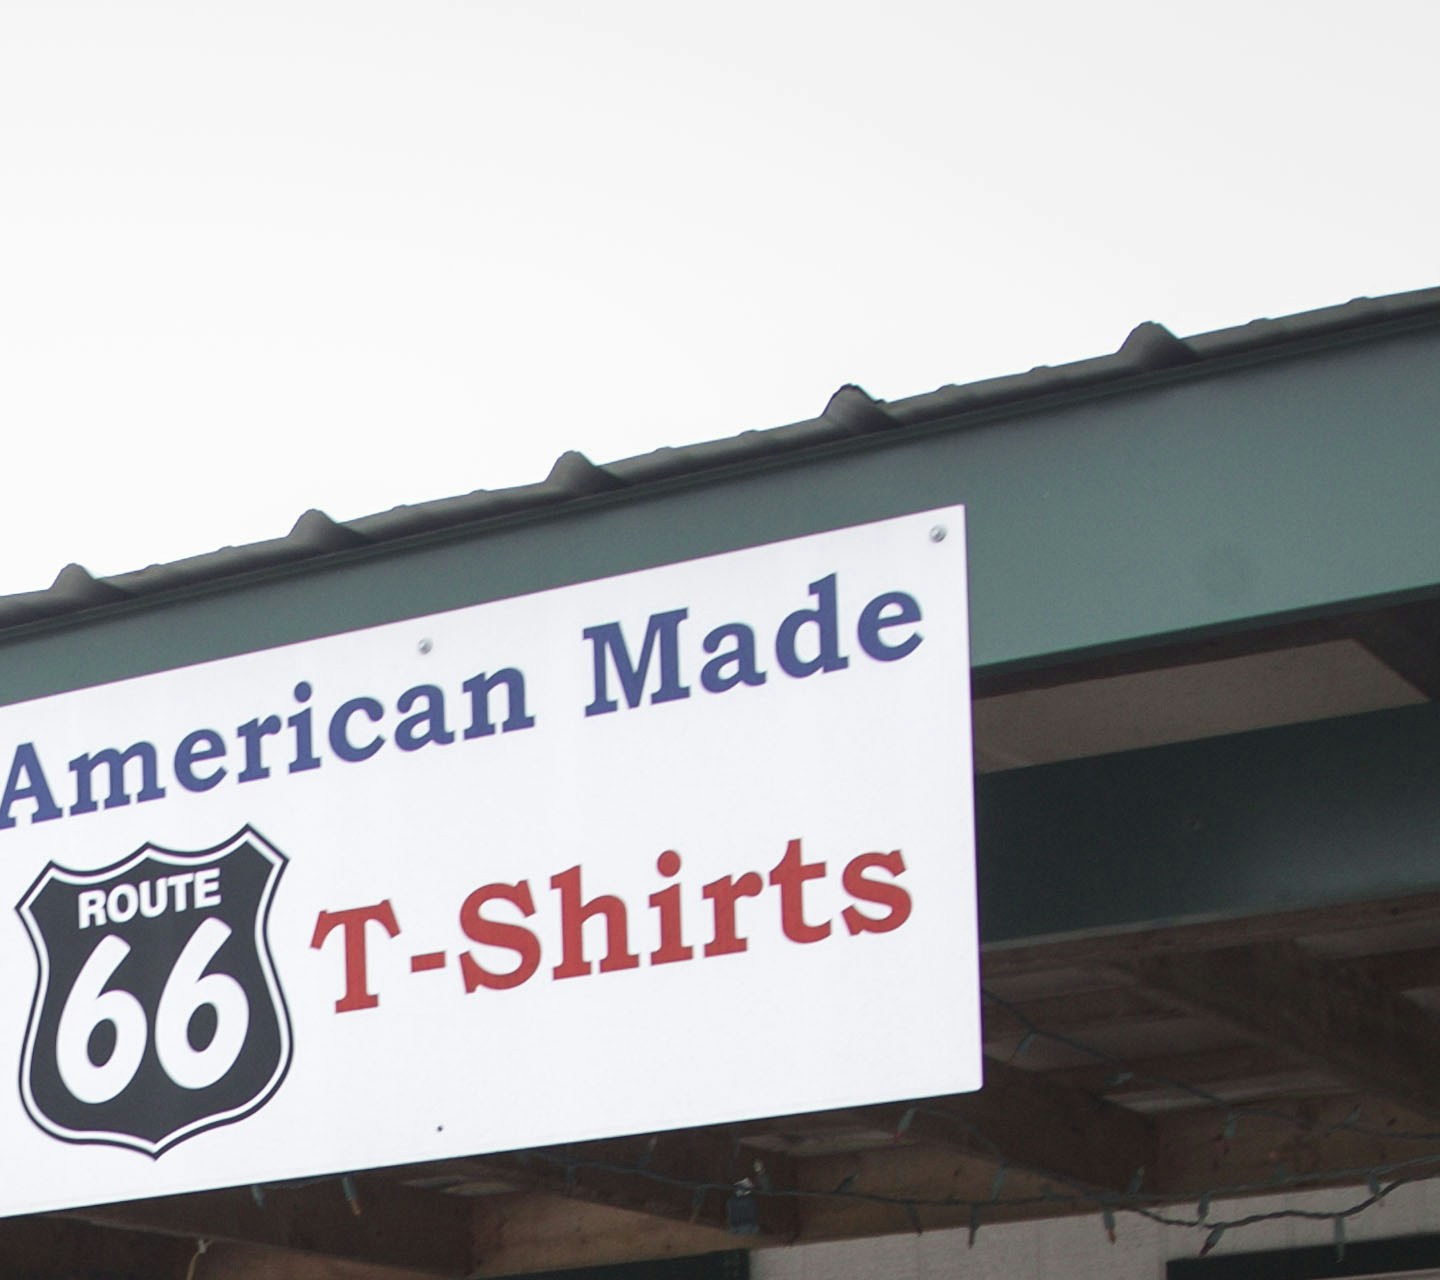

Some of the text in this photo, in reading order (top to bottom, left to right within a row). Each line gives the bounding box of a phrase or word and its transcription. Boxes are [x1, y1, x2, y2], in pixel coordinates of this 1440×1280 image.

[581, 572, 924, 719] Made
[77, 867, 223, 929] ROUTE
[309, 837, 914, 1015] T-Shirts
[55, 916, 251, 1104] 66
